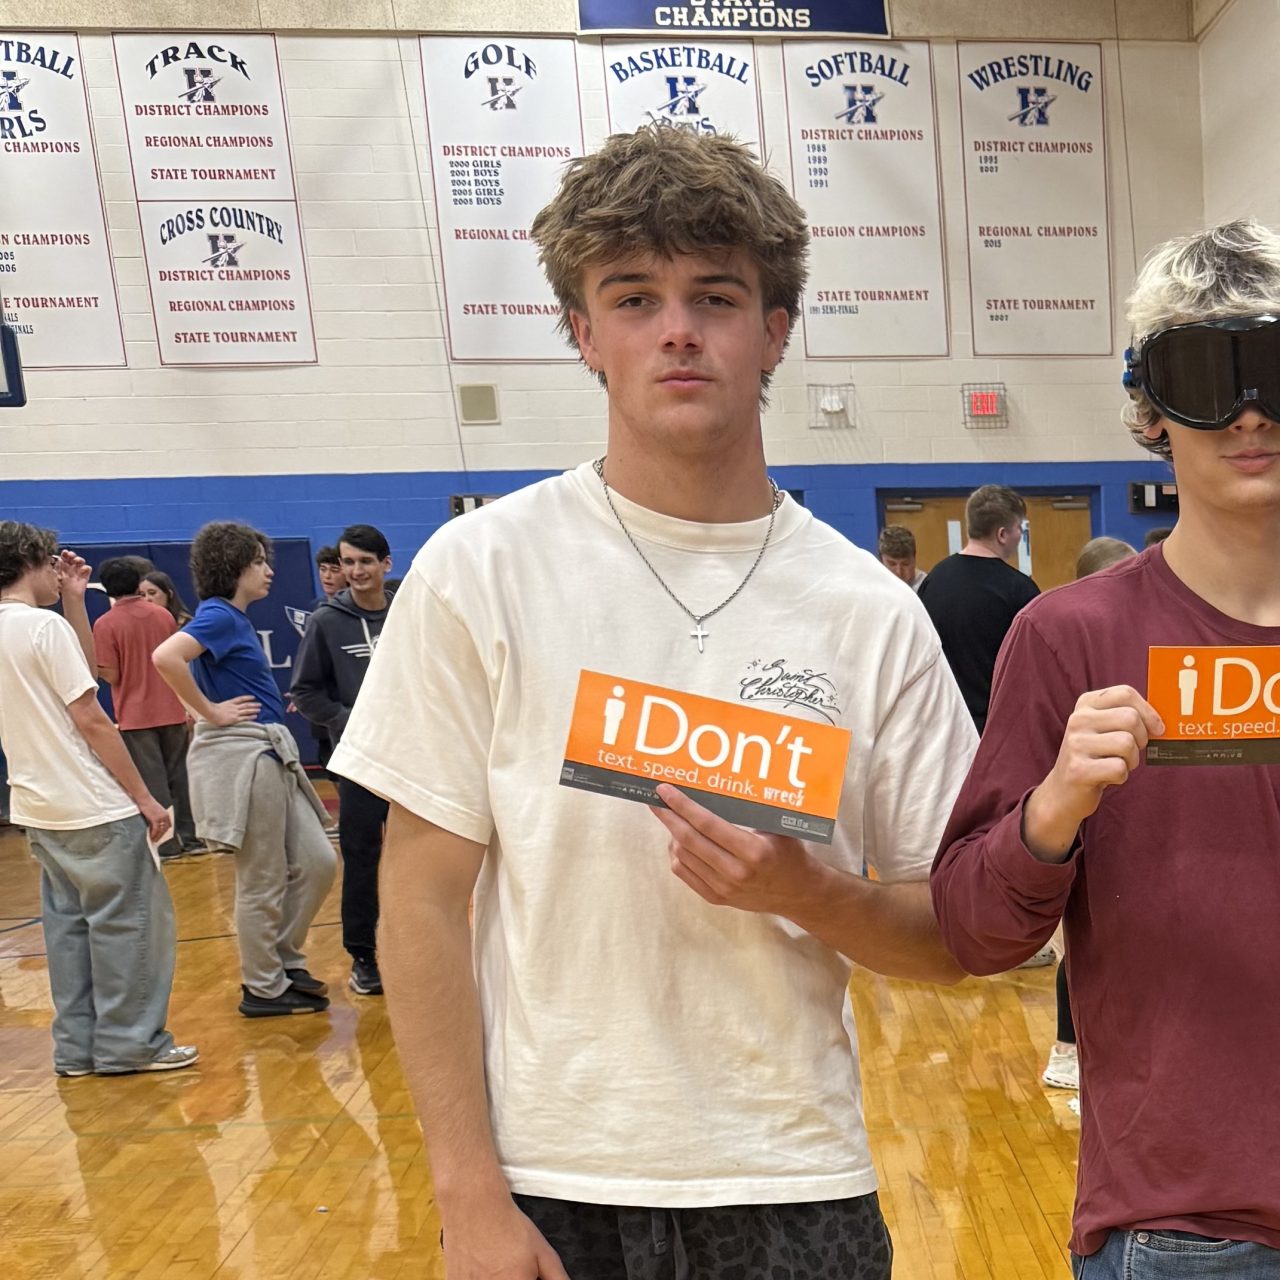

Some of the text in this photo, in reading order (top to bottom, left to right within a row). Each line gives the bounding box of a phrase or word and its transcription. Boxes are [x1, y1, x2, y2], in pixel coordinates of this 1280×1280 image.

[655, 7, 811, 28] CHAMPIONS
[145, 42, 251, 81] TRACK
[464, 44, 538, 80] GOLF
[610, 46, 750, 85] BASKETBALL
[805, 51, 911, 88] SOFTBALL
[968, 54, 1094, 94] WRESTLING
[135, 104, 269, 116] DISTRICT CHAMPIONS
[801, 129, 924, 141] DISTRICT CHAMPIONS
[4, 141, 81, 154] CHAMPIONS
[145, 136, 274, 148] REGIONAL CHAMPIONS
[973, 141, 1093, 154] DISTRICT CHAMPIONS
[443, 145, 572, 158] DISTRICT CHAMPIONS
[472, 160, 502, 168] GIRLS
[150, 168, 277, 181] STATE TOURNAMENT
[473, 169, 500, 177] BOYS
[475, 178, 501, 187] BOYS
[475, 188, 505, 196] GIRLS
[476, 197, 503, 206] BOYS
[159, 206, 284, 246] CROSS COUNTRY
[811, 226, 926, 238] REGION CHAMPIONS
[978, 226, 1098, 238] REGIONAL CHAMPIONS
[14, 233, 91, 246] CHAMPIONS
[455, 229, 510, 241] REGIONAL
[159, 269, 291, 282] DISTRICT CHAMPIONS
[14, 296, 99, 309] TOURNAMENT
[817, 290, 930, 302] STATE TOURNAMENT
[169, 299, 296, 312] REGIONAL CHAMPIONS
[463, 304, 560, 315] STATE TOURNAM
[985, 299, 1095, 310] STATE TOURNAMENT
[174, 331, 298, 343] STATE TOURNAMENT
[1178, 720, 1218, 736] text.
[1222, 716, 1280, 738] speed.
[597, 749, 805, 807] text. speed. drink. wreck
